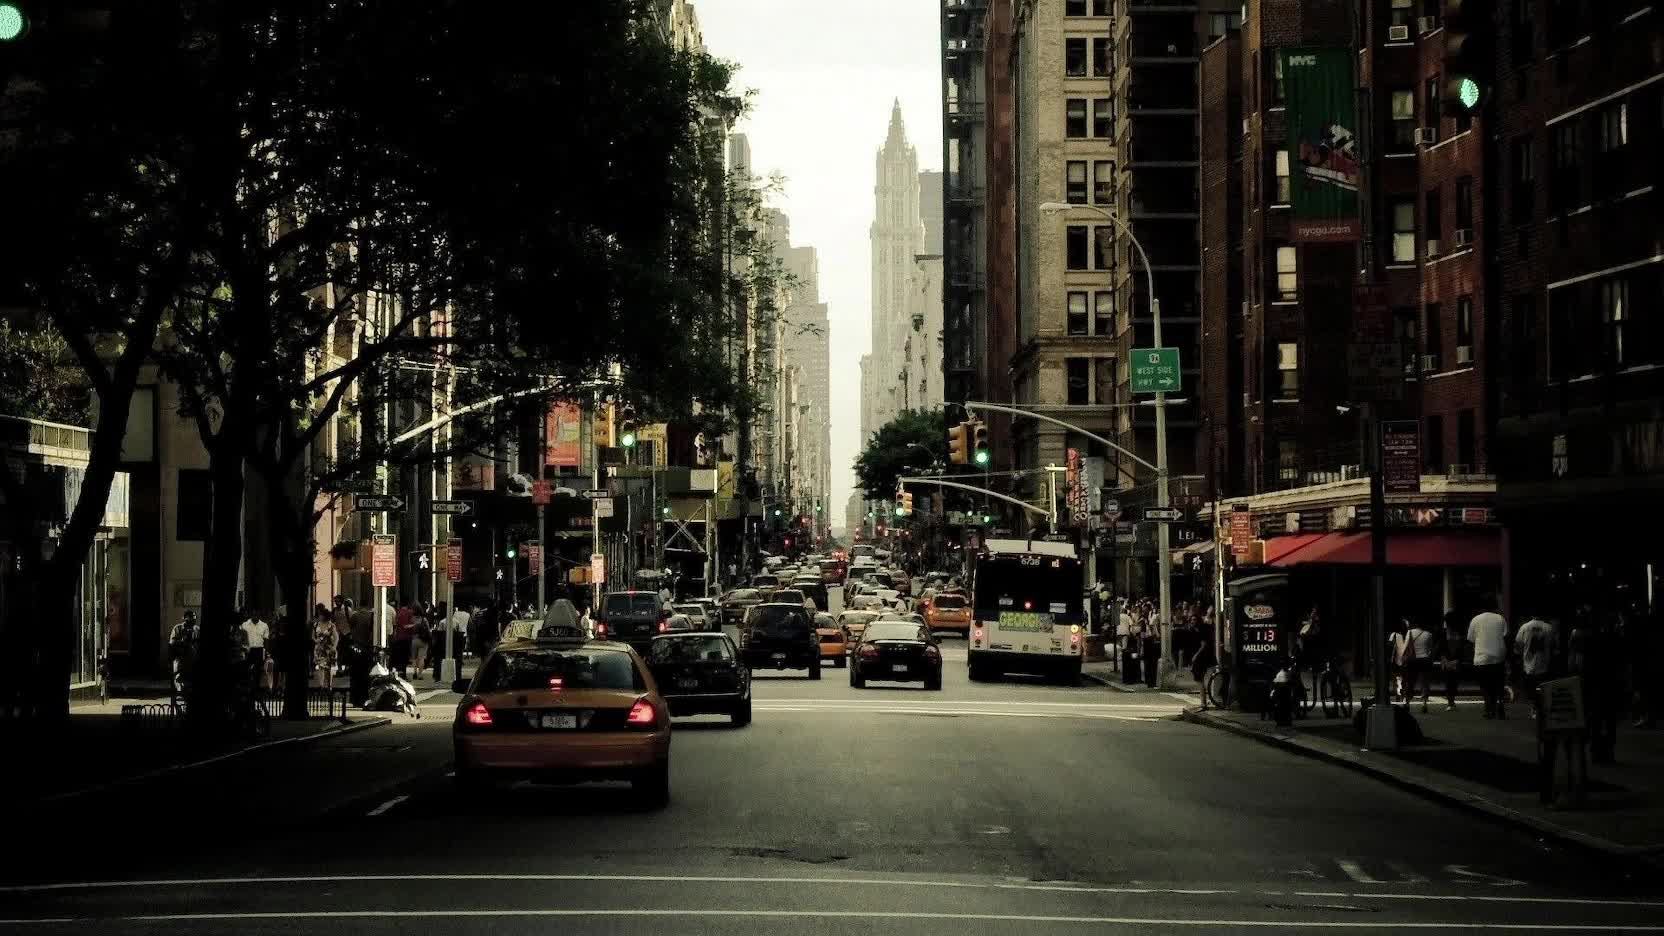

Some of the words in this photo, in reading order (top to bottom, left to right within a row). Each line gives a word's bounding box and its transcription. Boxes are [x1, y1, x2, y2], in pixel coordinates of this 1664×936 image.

[1289, 55, 1316, 66] NYC
[1298, 225, 1351, 237] nycgo.com
[1137, 367, 1154, 375] WEST
[1157, 366, 1173, 374] SIDE
[362, 499, 377, 507] ONE
[1242, 644, 1278, 652] MILLION
